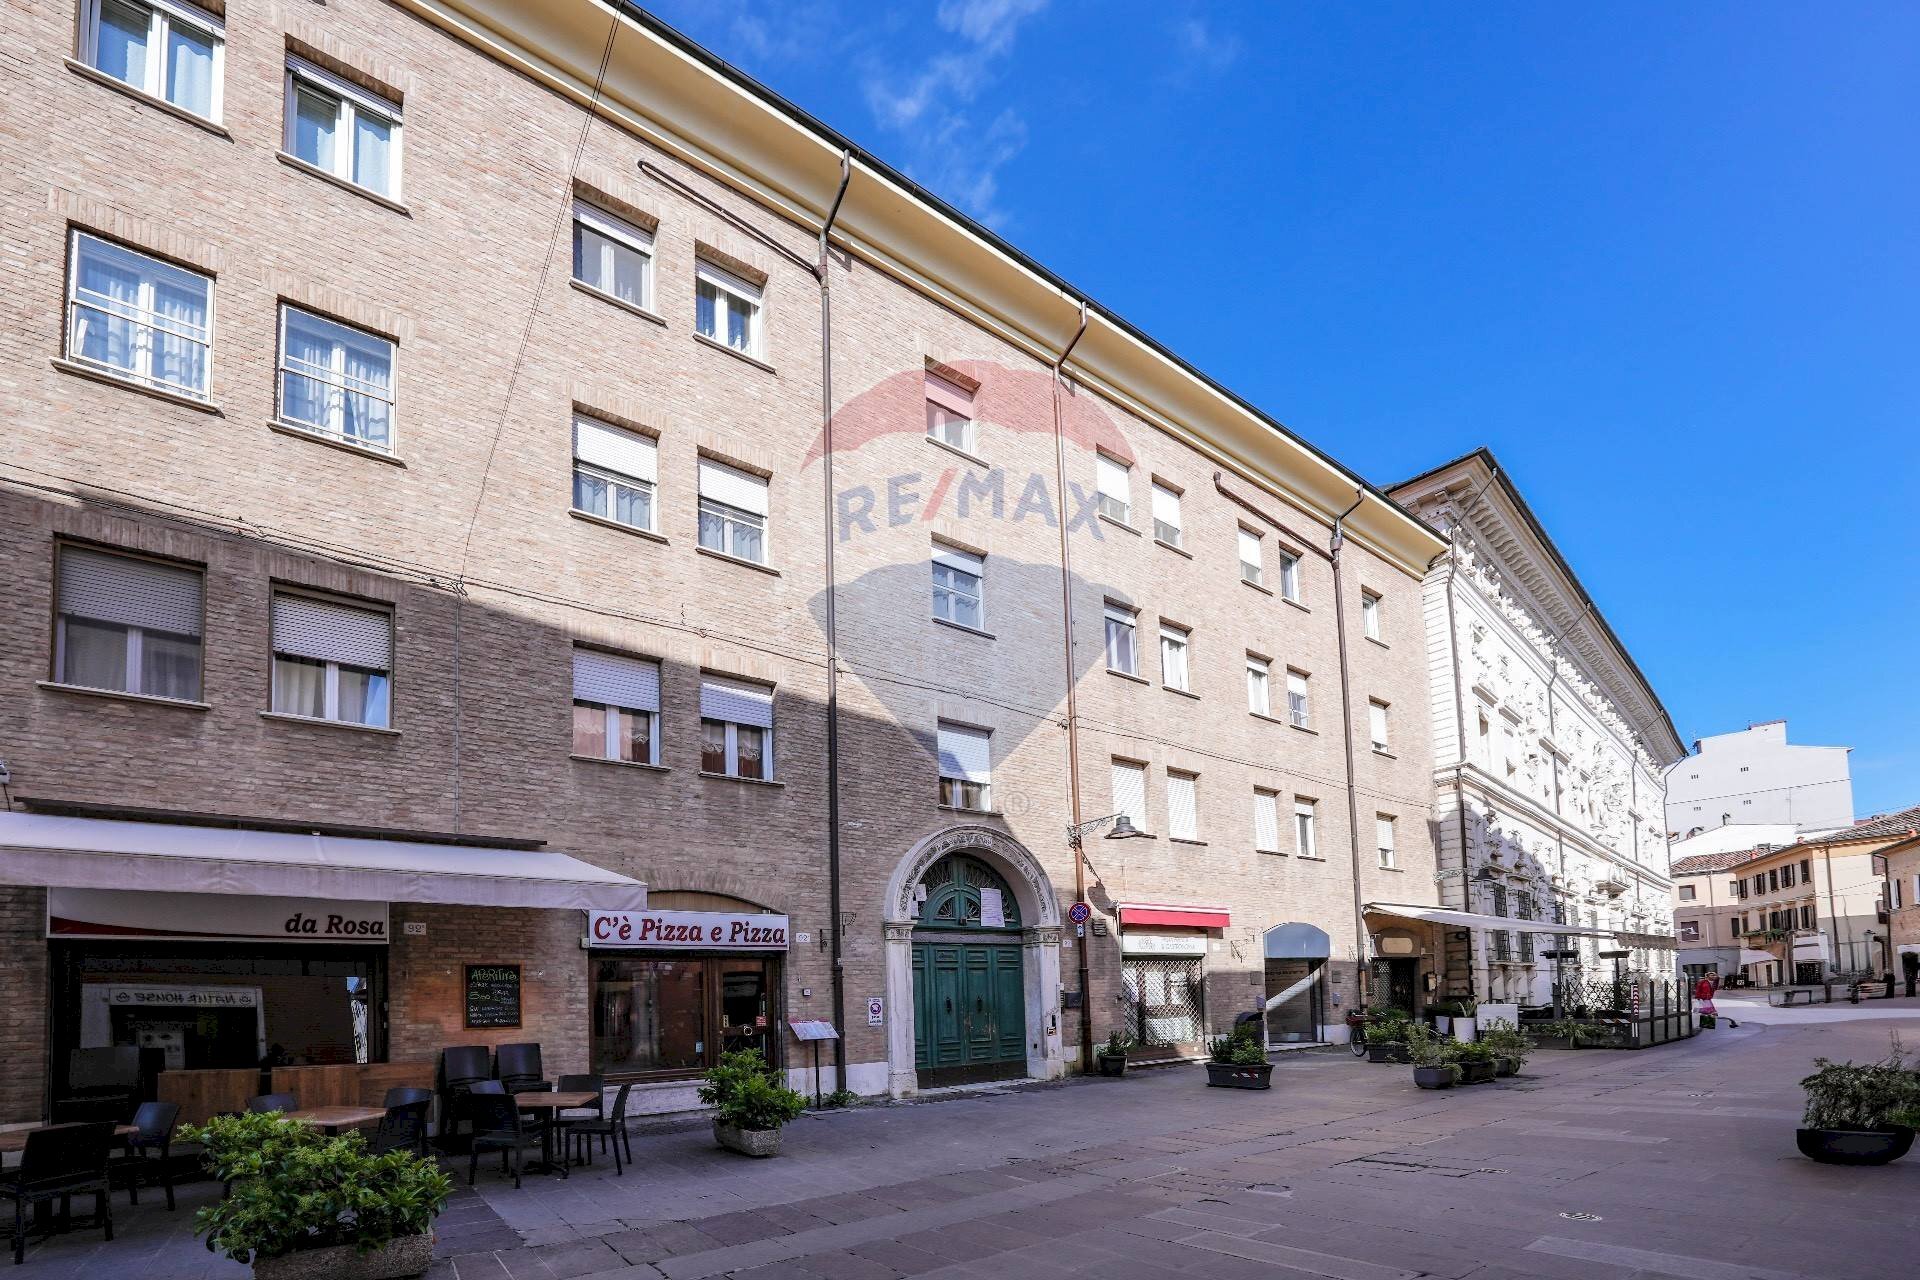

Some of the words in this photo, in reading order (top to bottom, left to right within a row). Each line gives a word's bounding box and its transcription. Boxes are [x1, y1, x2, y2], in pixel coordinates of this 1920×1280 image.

[285, 913, 317, 933] da
[325, 914, 384, 935] Rosa
[638, 917, 704, 942] Pizza
[710, 925, 723, 941] e
[728, 920, 786, 943] Pizza
